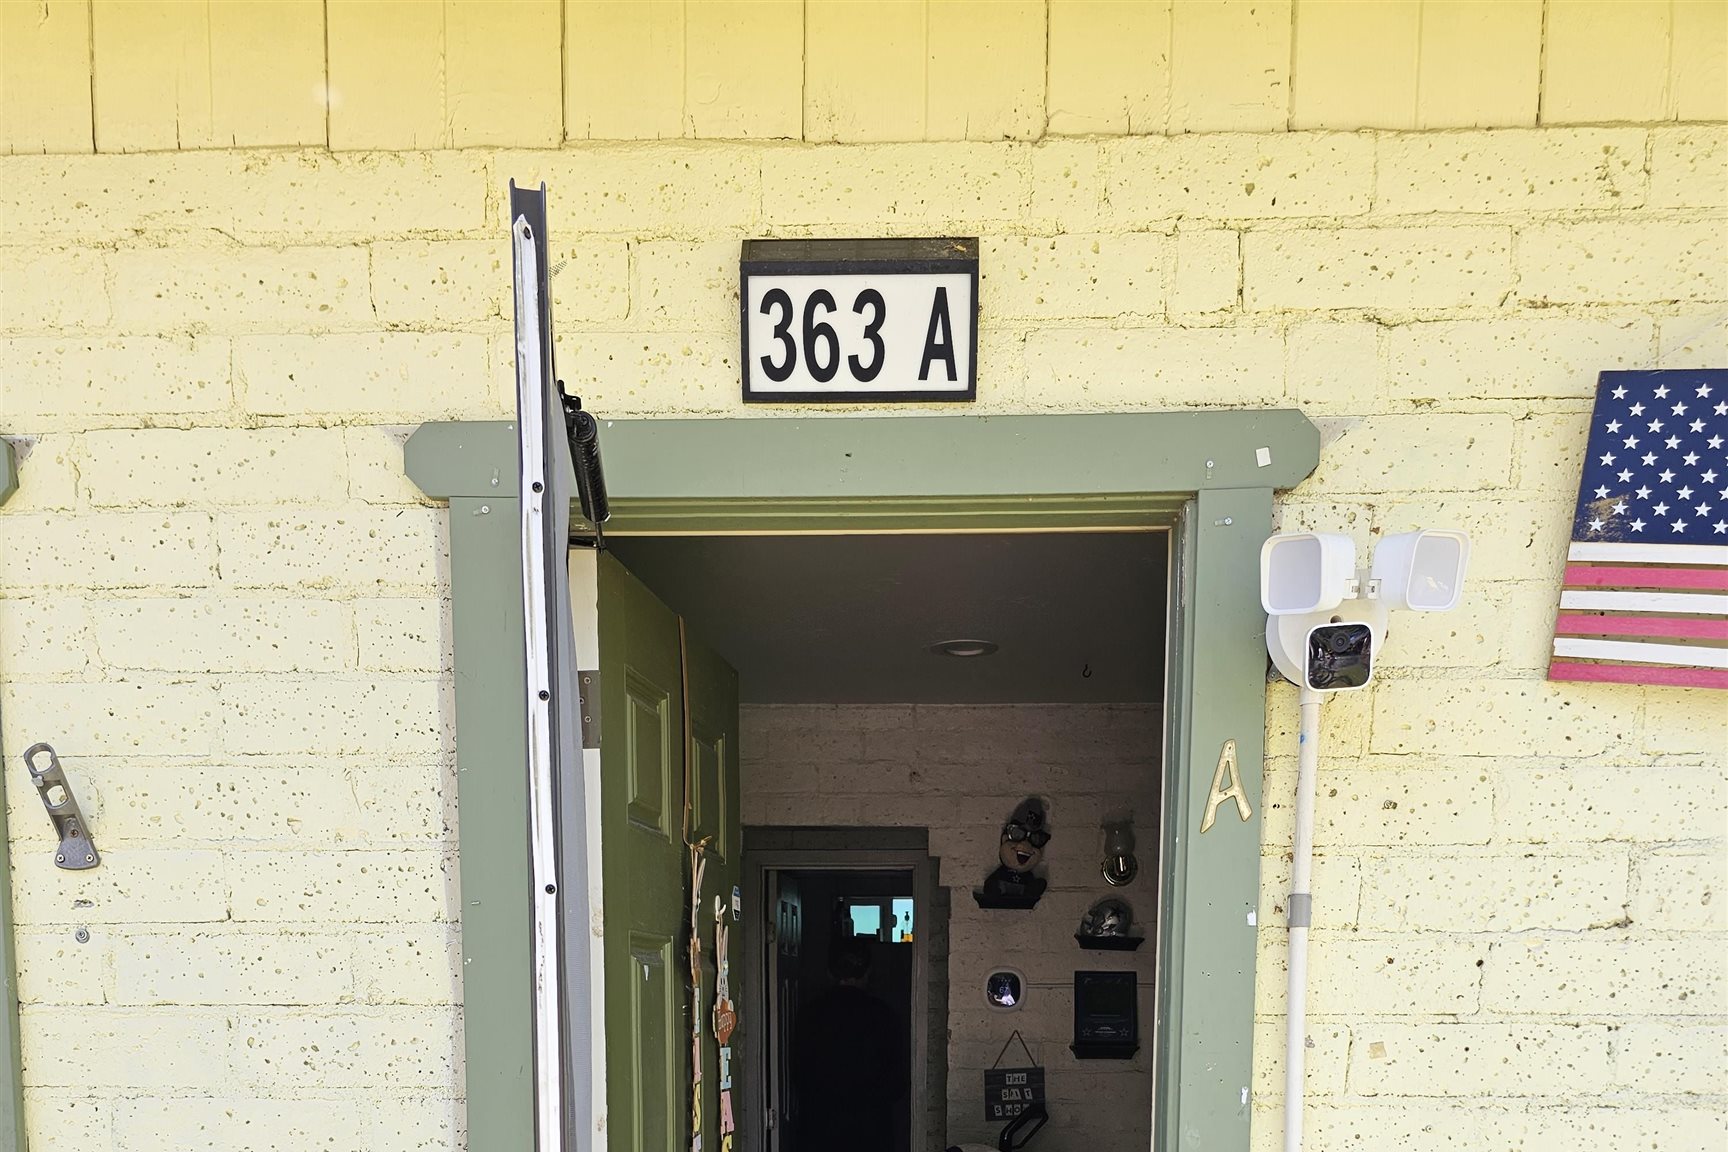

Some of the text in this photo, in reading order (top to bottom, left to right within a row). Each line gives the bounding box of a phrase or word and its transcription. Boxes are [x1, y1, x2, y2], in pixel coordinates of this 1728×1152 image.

[759, 286, 958, 383] 363 A
[1199, 738, 1253, 834] A
[1006, 1074, 1026, 1083] THE
[995, 1105, 1024, 1115] SHO
